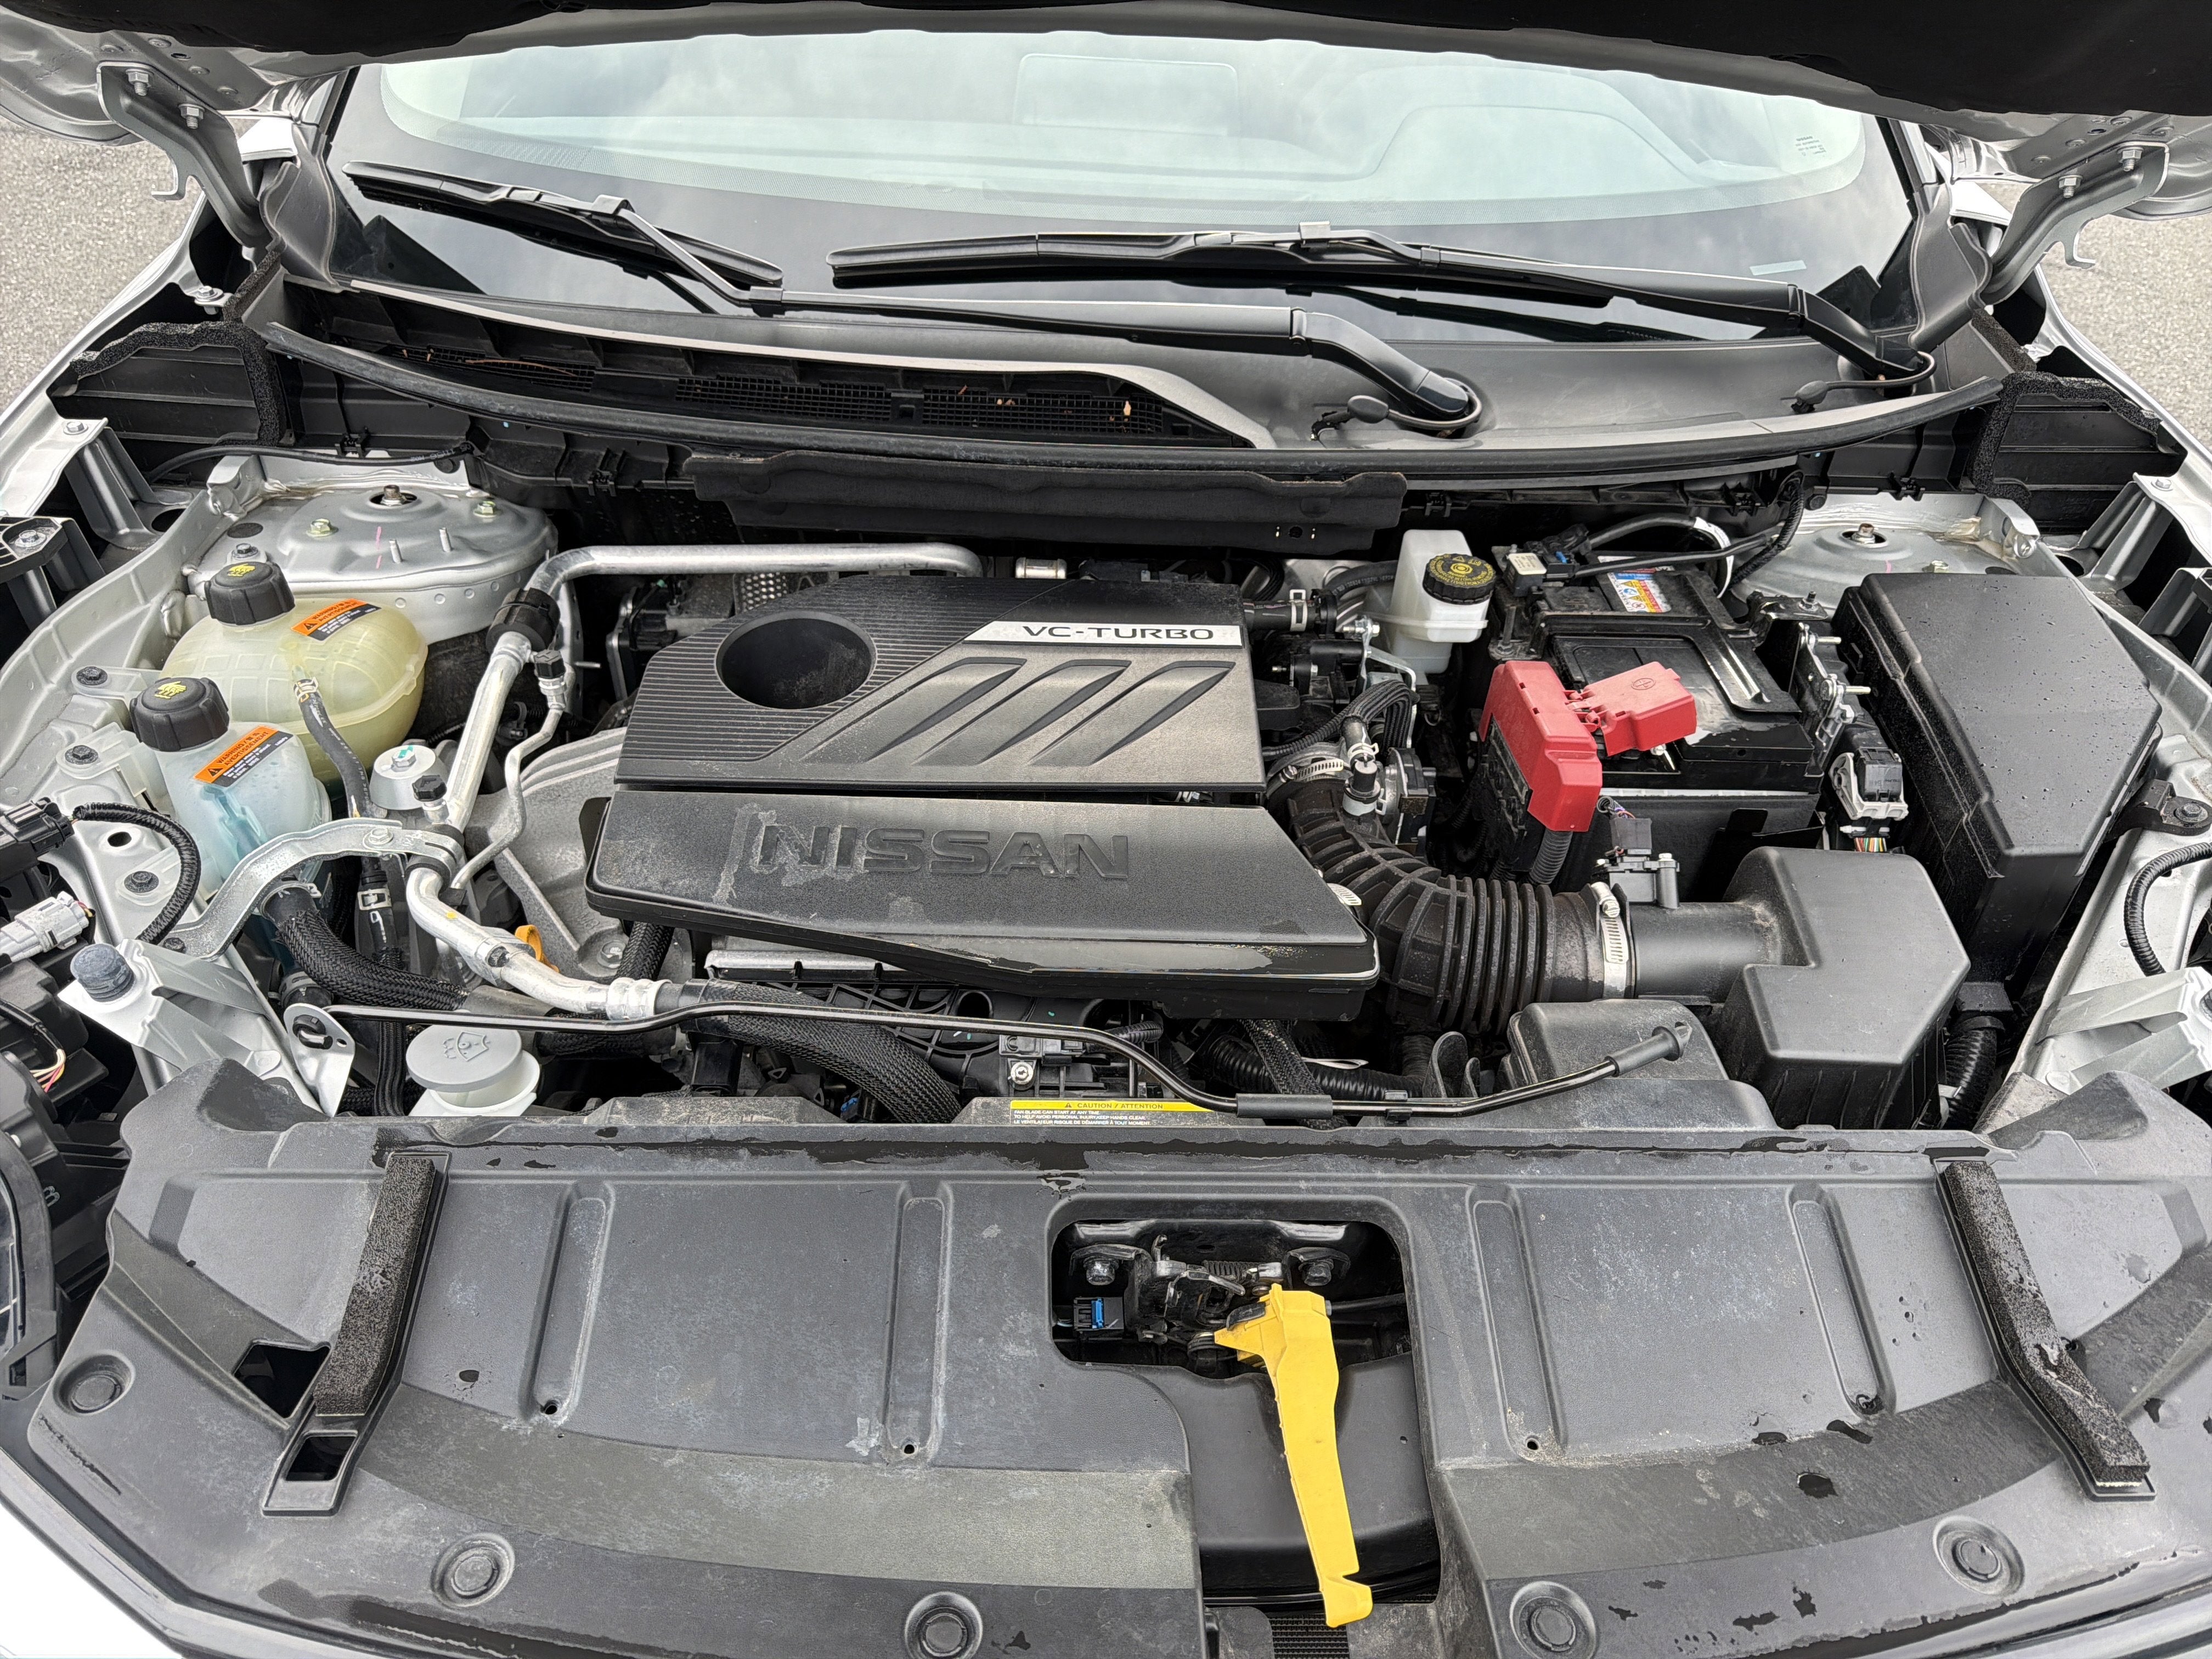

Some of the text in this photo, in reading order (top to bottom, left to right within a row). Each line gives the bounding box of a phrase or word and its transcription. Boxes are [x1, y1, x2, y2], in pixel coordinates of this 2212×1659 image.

[1022, 625, 1214, 640] VC-TURBO
[216, 743, 245, 764] WARNING
[756, 824, 1128, 879] NISSAN
